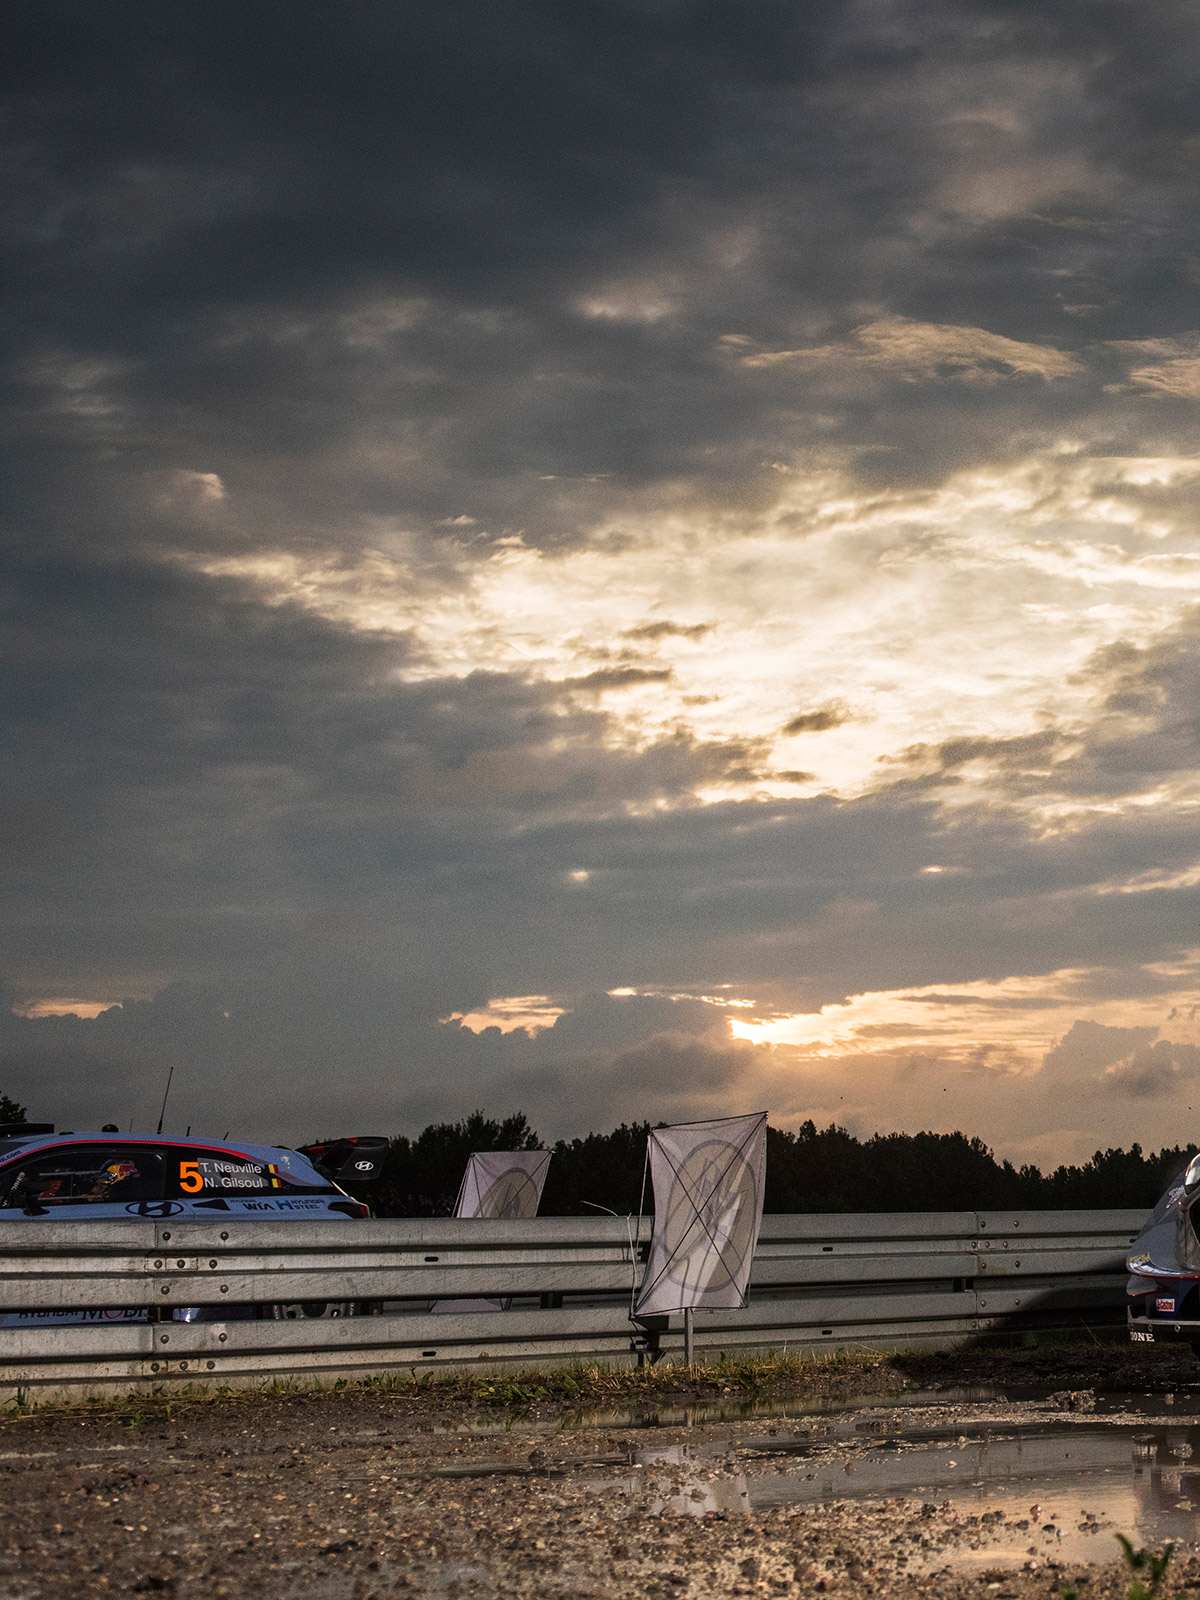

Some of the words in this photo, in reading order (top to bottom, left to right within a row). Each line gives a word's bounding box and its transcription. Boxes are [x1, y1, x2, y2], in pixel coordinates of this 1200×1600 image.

[200, 1162, 212, 1173] T.
[214, 1162, 262, 1174] Neuville
[180, 1162, 204, 1193] 5
[204, 1178, 219, 1188] N.
[221, 1177, 263, 1188] Gilsoul
